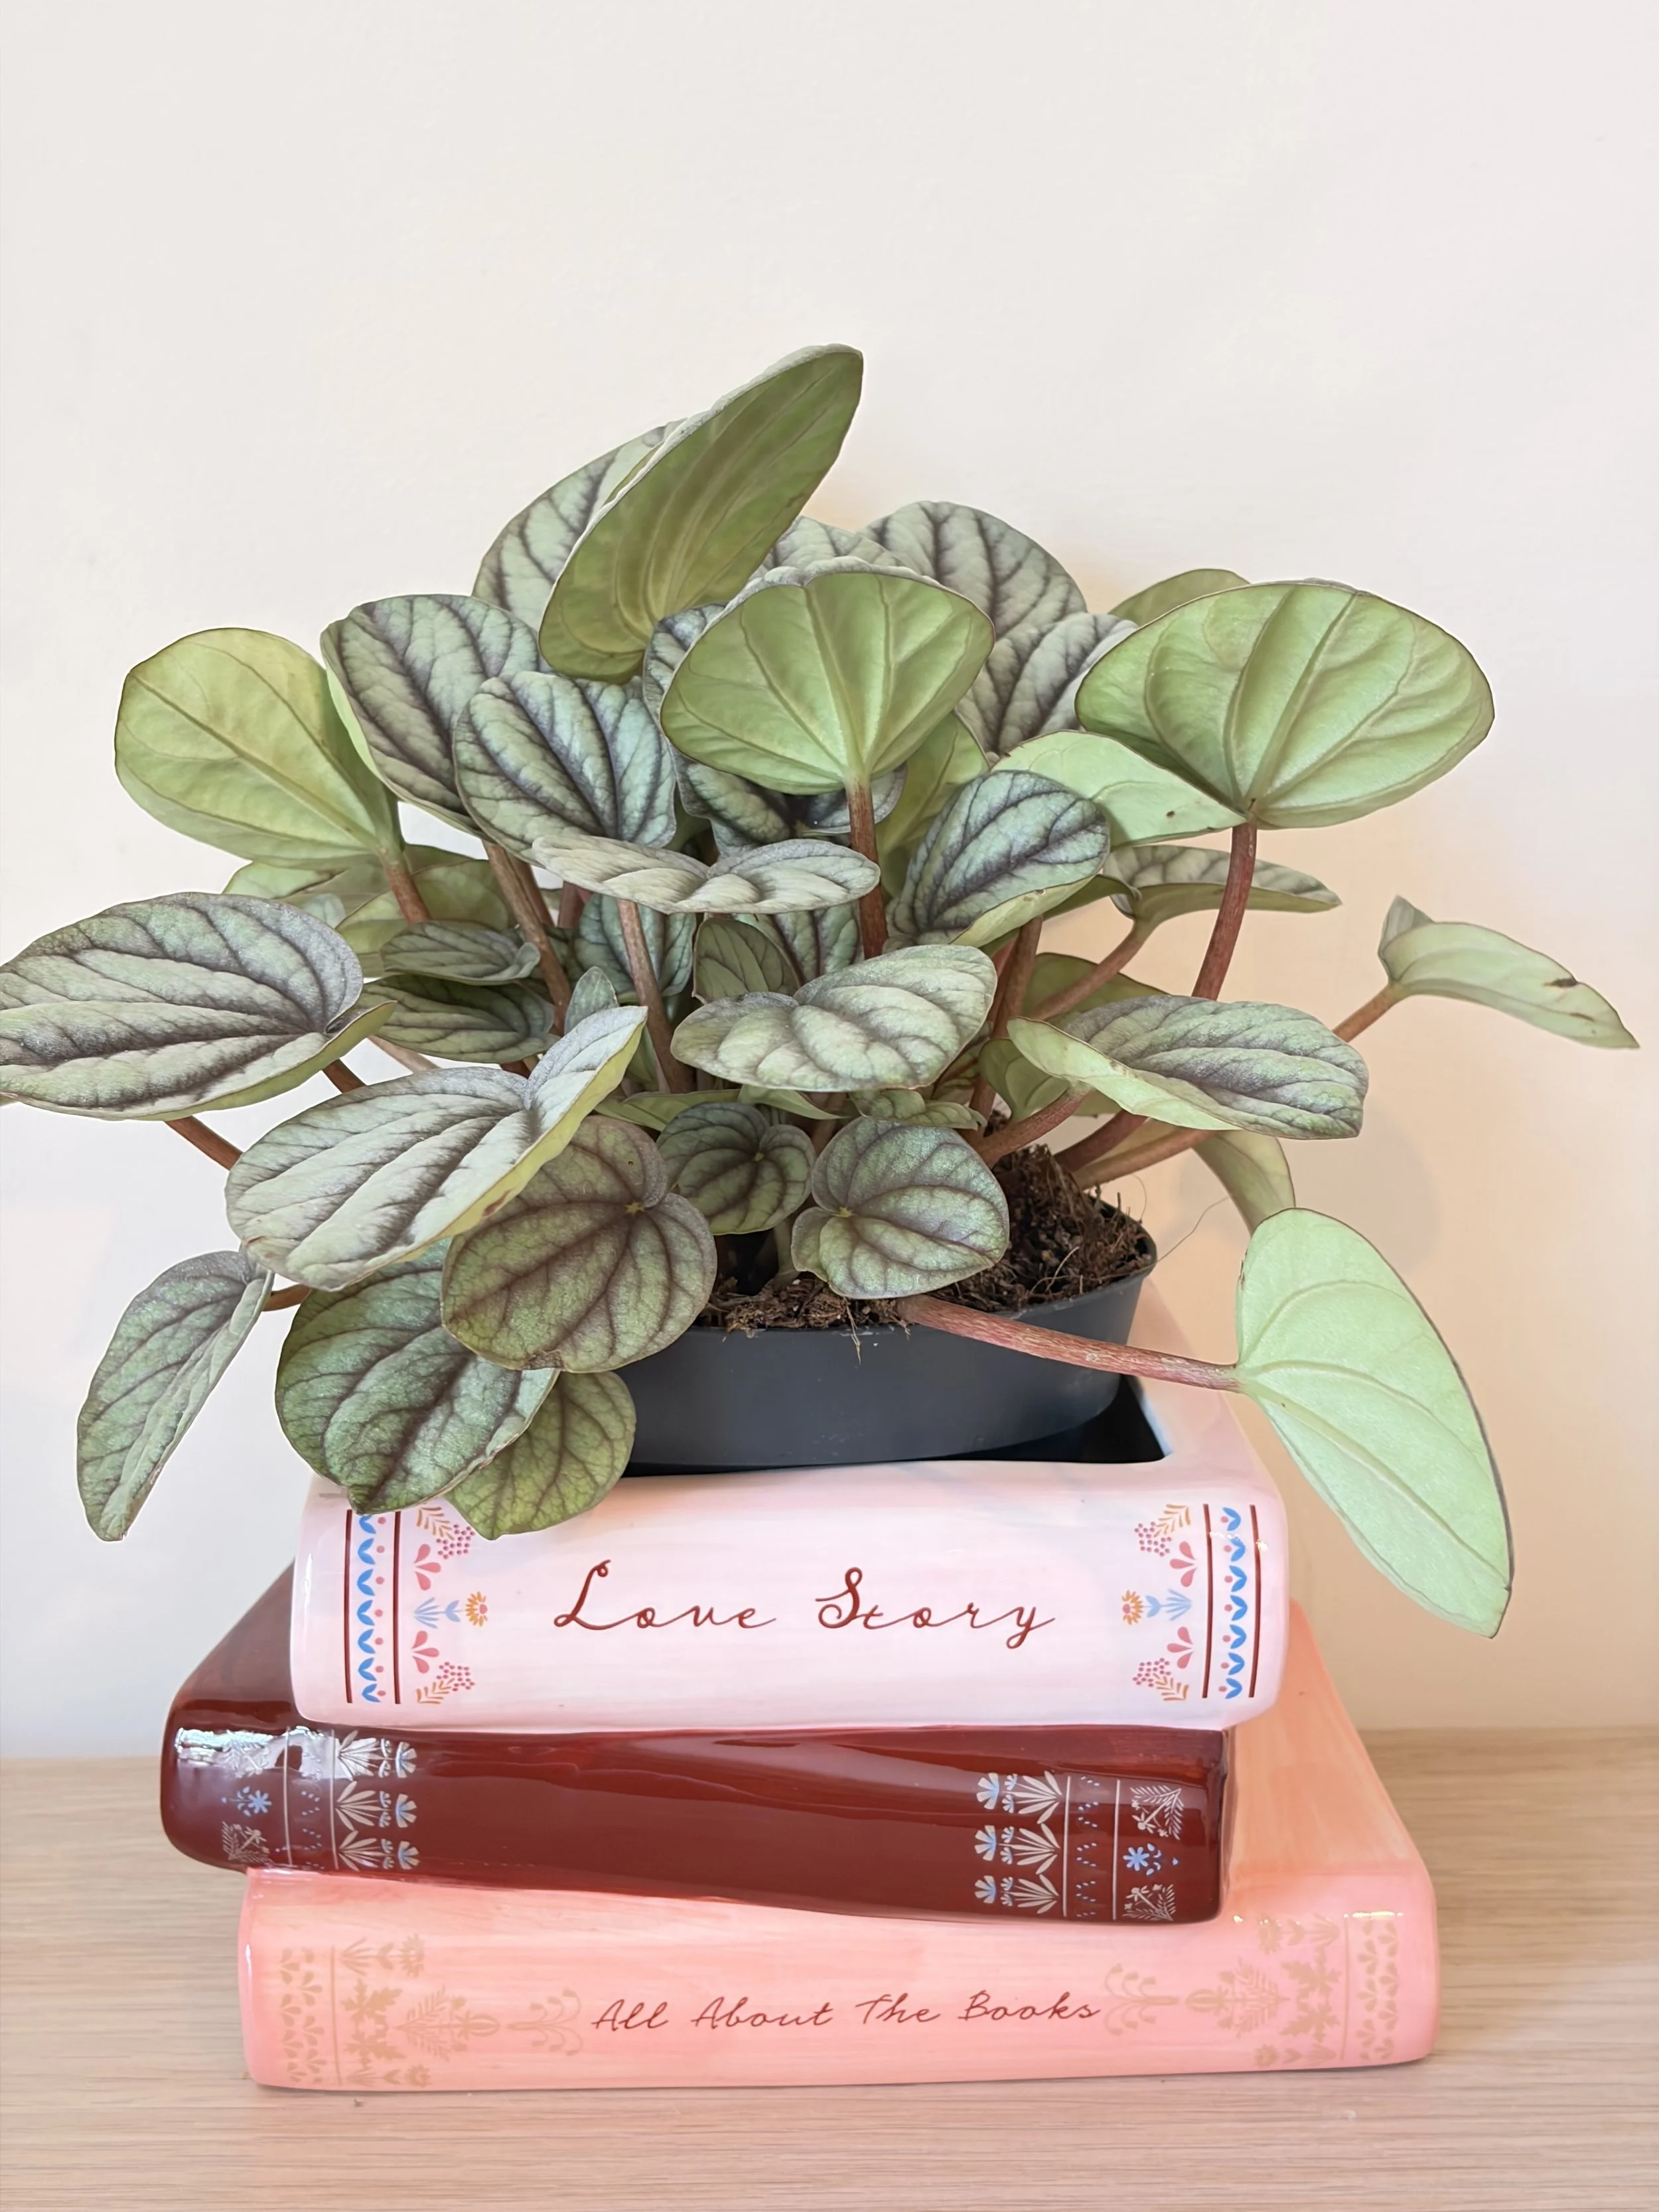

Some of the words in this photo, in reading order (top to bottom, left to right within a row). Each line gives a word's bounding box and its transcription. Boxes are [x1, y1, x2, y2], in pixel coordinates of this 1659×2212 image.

[553, 1559, 777, 1631] Love
[814, 1566, 1055, 1650] Story
[592, 2000, 669, 2031] All
[691, 1997, 833, 2029] About
[856, 1993, 942, 2024] The
[958, 1990, 1101, 2022] Books
